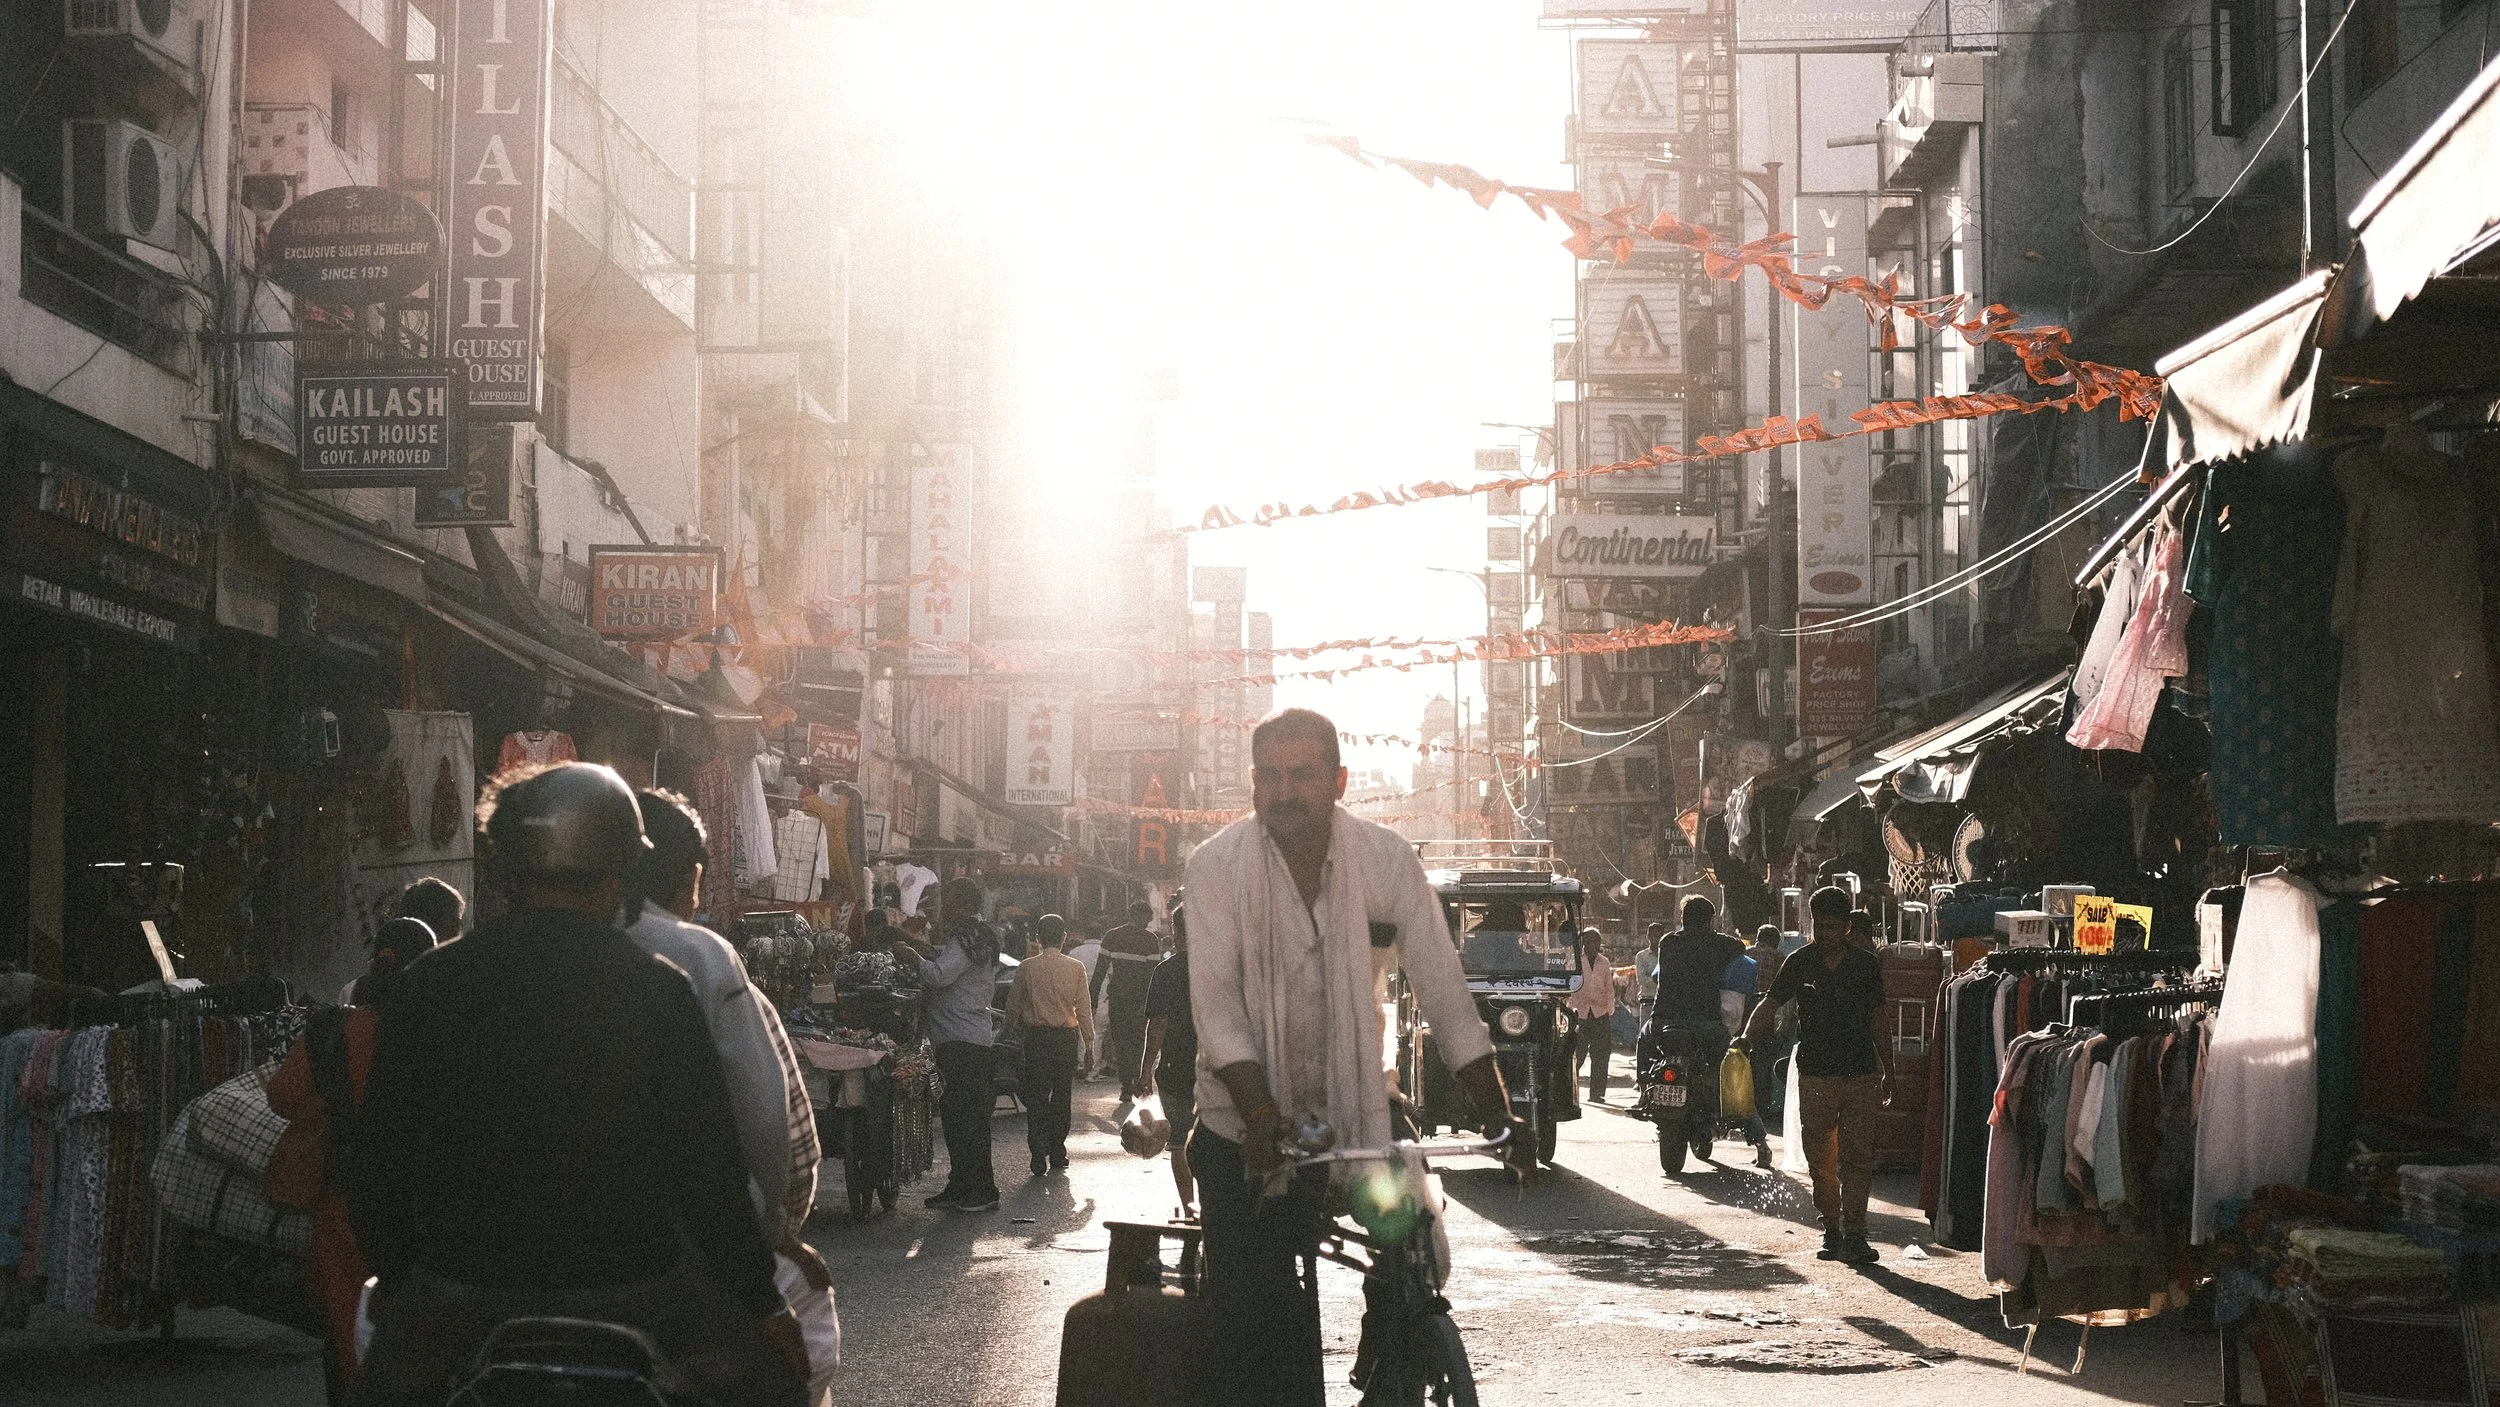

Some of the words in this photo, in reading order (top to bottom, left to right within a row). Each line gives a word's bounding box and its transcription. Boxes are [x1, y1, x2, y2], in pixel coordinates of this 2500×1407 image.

[1755, 12, 1826, 23] FACTORY
[1833, 11, 1881, 22] PRICE
[1781, 29, 1836, 38] SILVER
[284, 246, 336, 260] EXCLUSIVE
[339, 244, 372, 257] SILVER
[373, 242, 428, 256] JEWELLERY
[321, 268, 357, 280] SINCE
[361, 266, 388, 279] 1979
[453, 339, 526, 359] GUEST
[468, 364, 527, 384] OUSE
[308, 387, 445, 418] KAILASH
[477, 391, 526, 401] APPROVED
[313, 426, 371, 445] GUEST
[378, 425, 438, 444] HOUSE
[320, 450, 357, 465] GOVT.
[363, 449, 430, 465] APPROVED
[1556, 525, 1714, 567] Continental
[601, 564, 708, 590] KIRAN
[21, 574, 64, 609] RETAIL
[559, 575, 588, 615] KIRAN
[606, 593, 701, 610] GUEST
[69, 590, 135, 630] WHOLESALE
[136, 610, 177, 642] EXPORT
[605, 611, 701, 628] HOUSE
[1813, 690, 1860, 698] FACTORY
[1806, 700, 1836, 708] PRICE
[1839, 700, 1866, 708] SHOP
[814, 742, 858, 762] ATM
[1008, 789, 1069, 801] INTERNATIONAL
[1000, 853, 1062, 867] BAR
[2087, 907, 2108, 923] SALE
